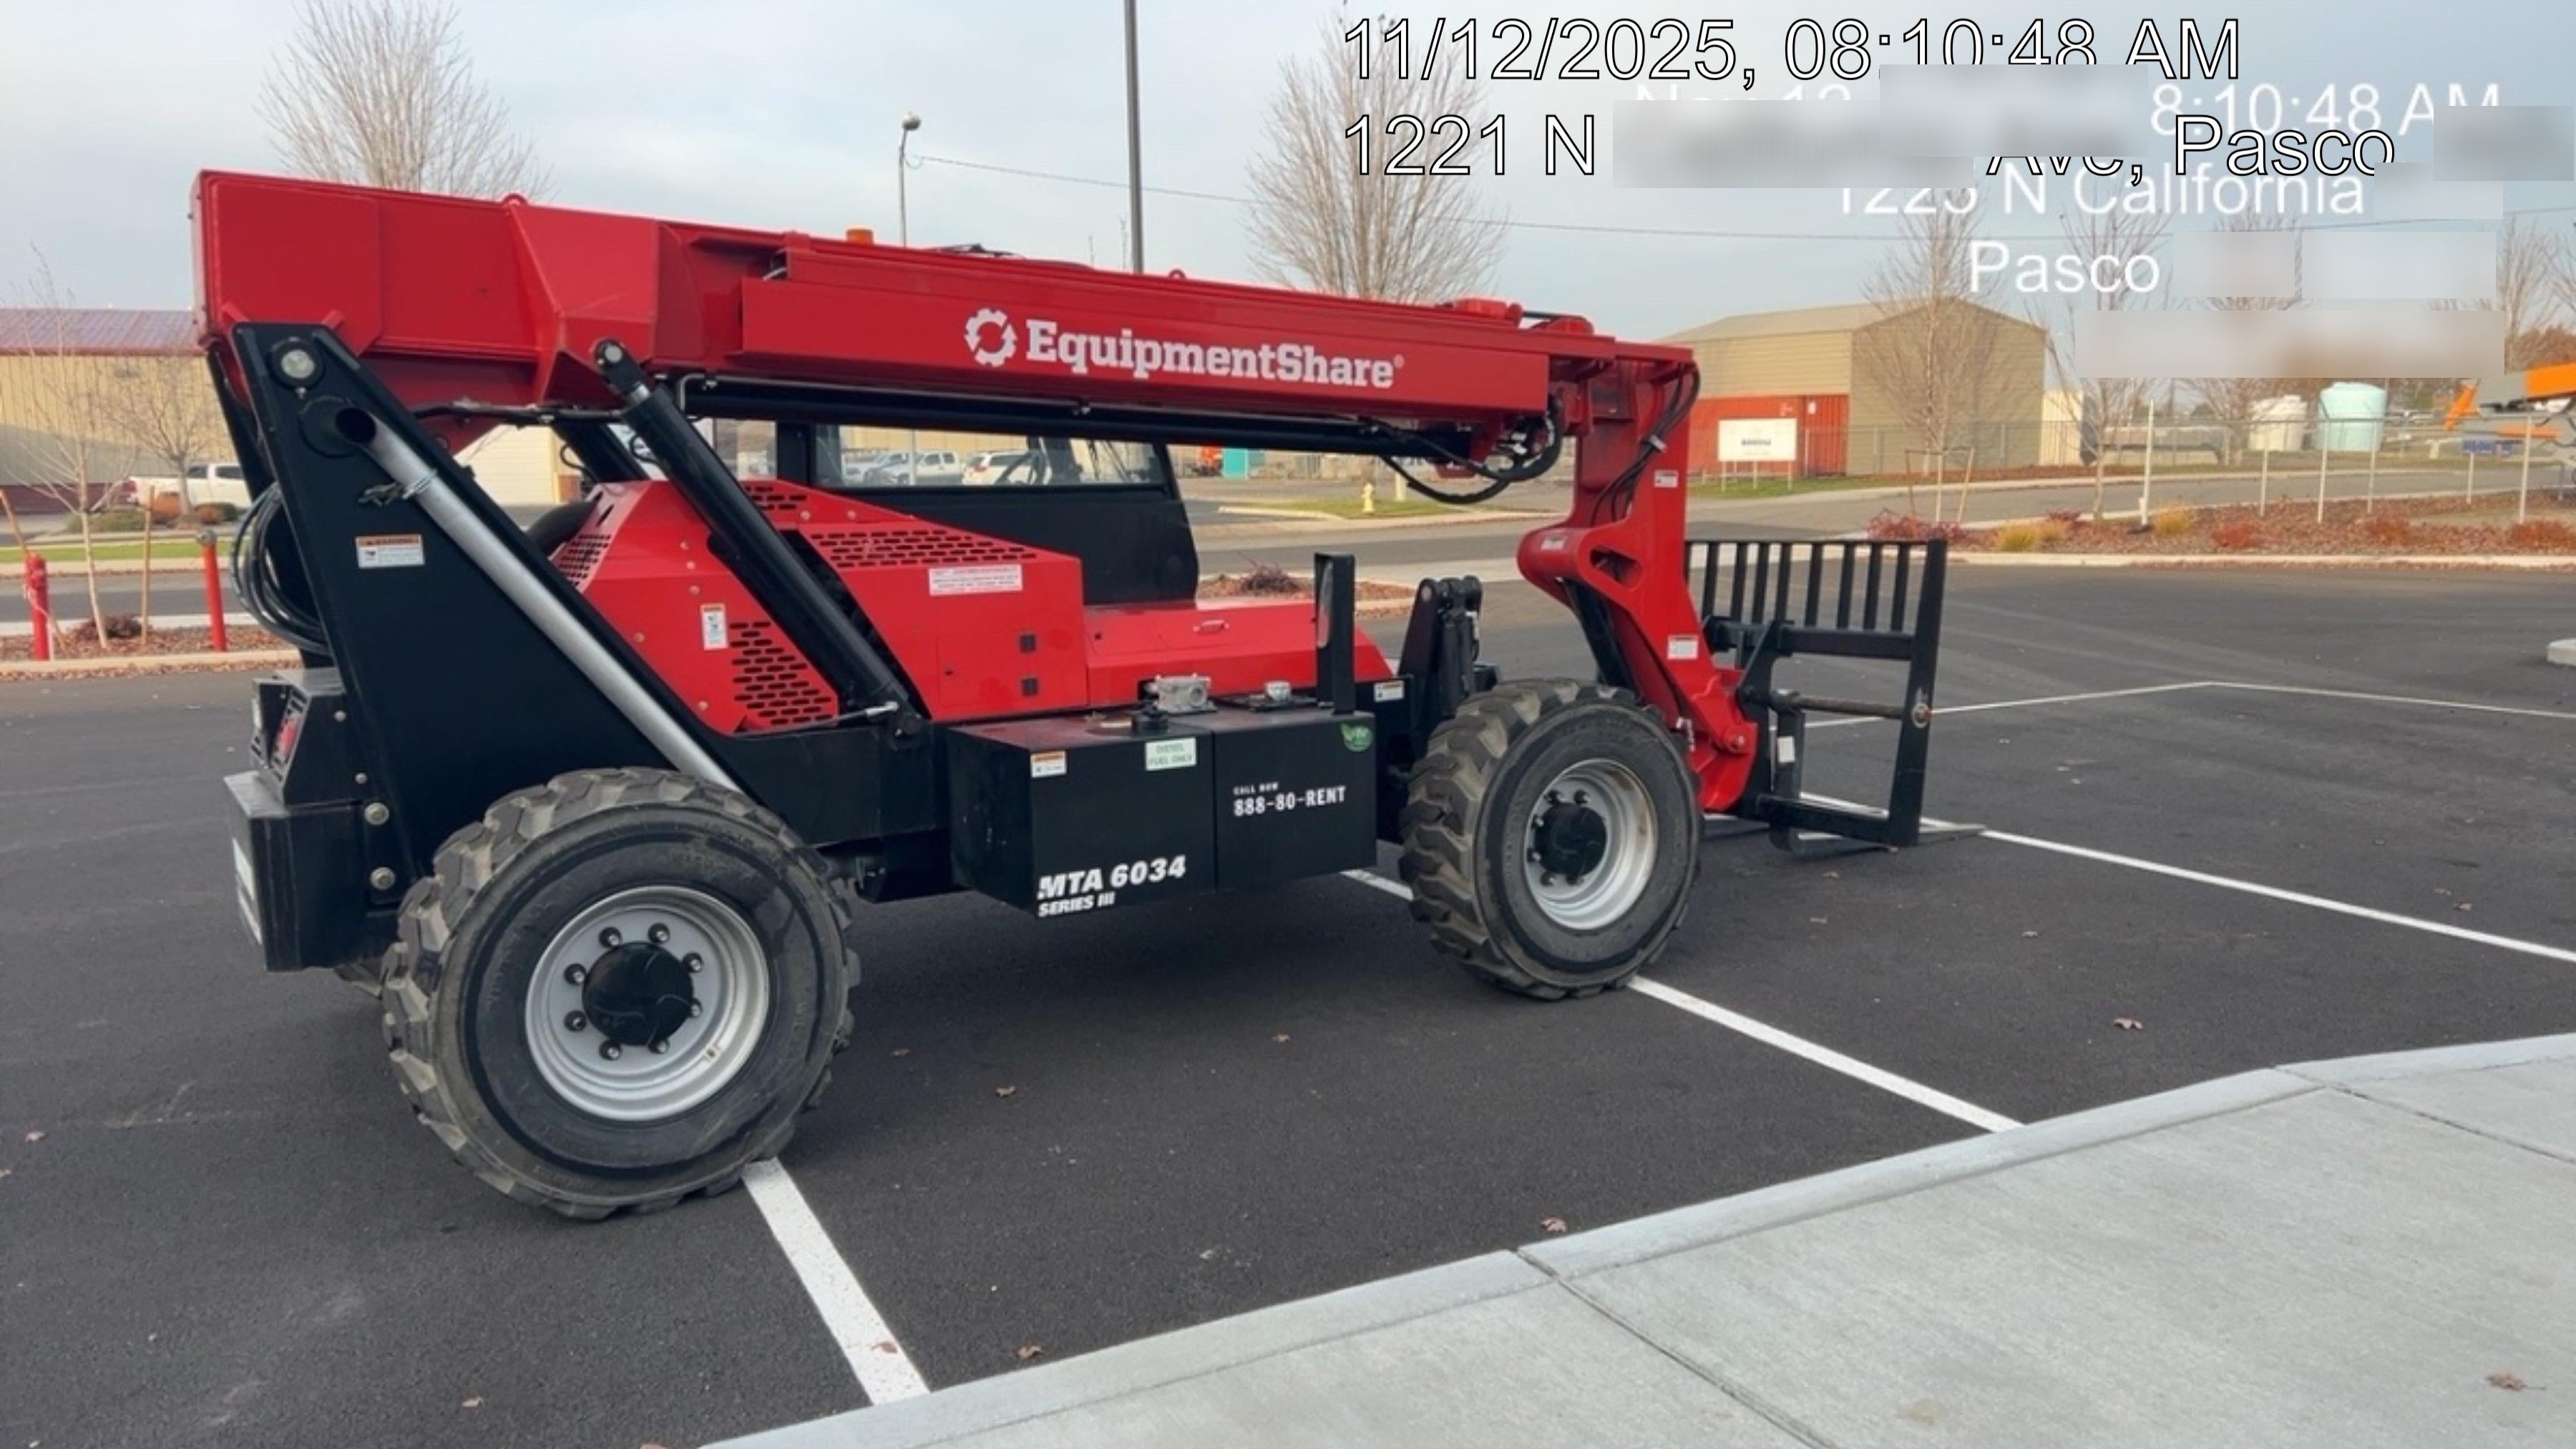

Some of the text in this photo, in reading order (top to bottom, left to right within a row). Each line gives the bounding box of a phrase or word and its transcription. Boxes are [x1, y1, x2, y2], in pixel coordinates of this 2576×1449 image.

[1234, 785, 1346, 816] 888-80-RENT
[1037, 854, 1186, 899] MTA 6034
[1038, 895, 1095, 918] SERIES
